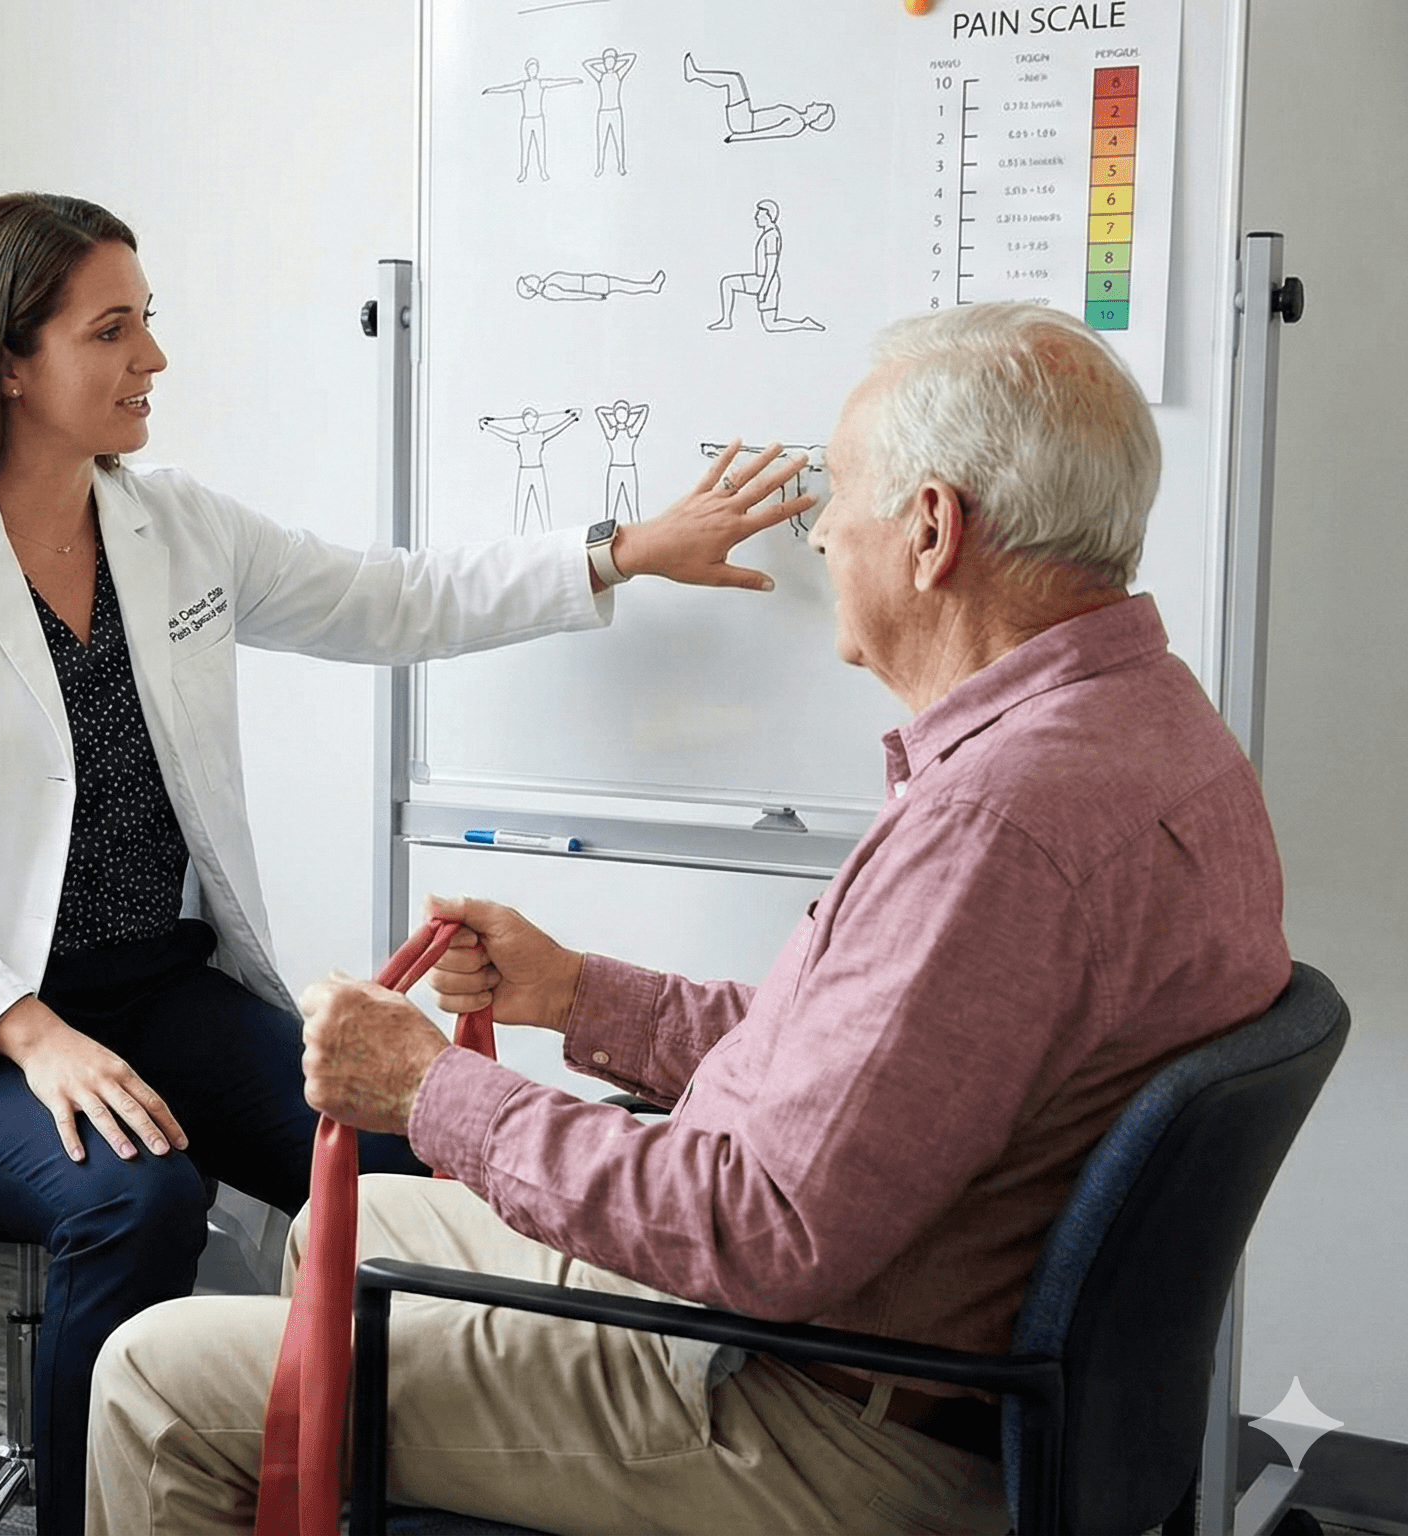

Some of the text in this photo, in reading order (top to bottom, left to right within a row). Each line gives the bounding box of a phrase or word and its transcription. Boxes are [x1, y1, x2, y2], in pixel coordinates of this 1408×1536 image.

[953, 1, 1126, 39] PAIN SCALE
[936, 76, 952, 90] 10
[1111, 105, 1120, 118] 2
[936, 133, 945, 145] 2
[1108, 135, 1118, 147] 4
[936, 160, 944, 173] 3
[1108, 164, 1117, 178] 5
[934, 187, 943, 199] 4
[1107, 192, 1116, 206] 6
[933, 214, 942, 227] 5
[1106, 222, 1115, 235] 7
[932, 242, 942, 255] 6
[1104, 251, 1114, 264] 8
[931, 270, 940, 282] 7
[1103, 280, 1113, 292] 9
[930, 297, 940, 310] 8
[1100, 310, 1115, 320] 10
